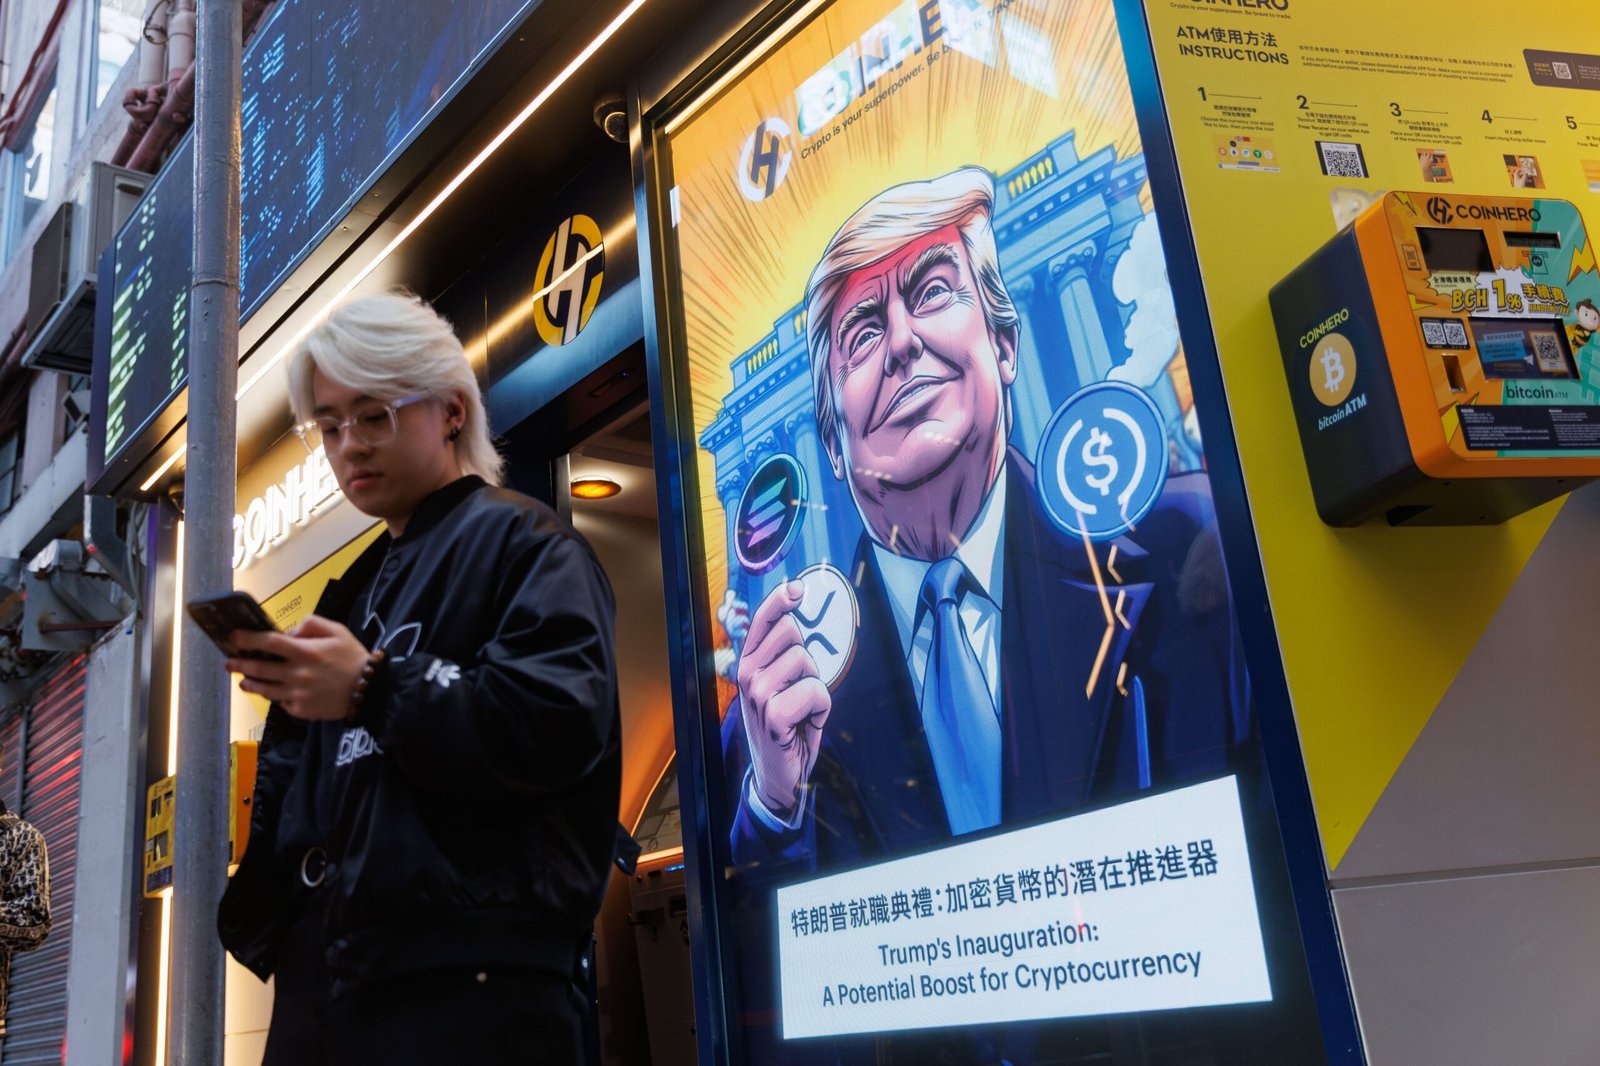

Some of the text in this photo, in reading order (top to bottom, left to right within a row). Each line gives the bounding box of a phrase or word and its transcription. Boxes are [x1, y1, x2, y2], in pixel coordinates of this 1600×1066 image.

[1177, 26, 1278, 48] ATM使用方法
[1179, 43, 1290, 65] INSTRUCTIONS
[800, 50, 941, 160] Crypto is your superpower. Be
[1198, 87, 1207, 101] 1
[1296, 95, 1309, 109] 2
[1389, 103, 1402, 117] 3
[1481, 110, 1492, 124] 4
[1565, 116, 1577, 130] 5
[1456, 204, 1541, 222] COINHERO
[1452, 288, 1489, 311] BCH
[1492, 278, 1524, 312] 1%
[1299, 308, 1349, 349] COINHERO
[878, 920, 1099, 966] Trump's Inauguration:
[823, 951, 1201, 1007] A Potential Boost for Cryptocurrency
